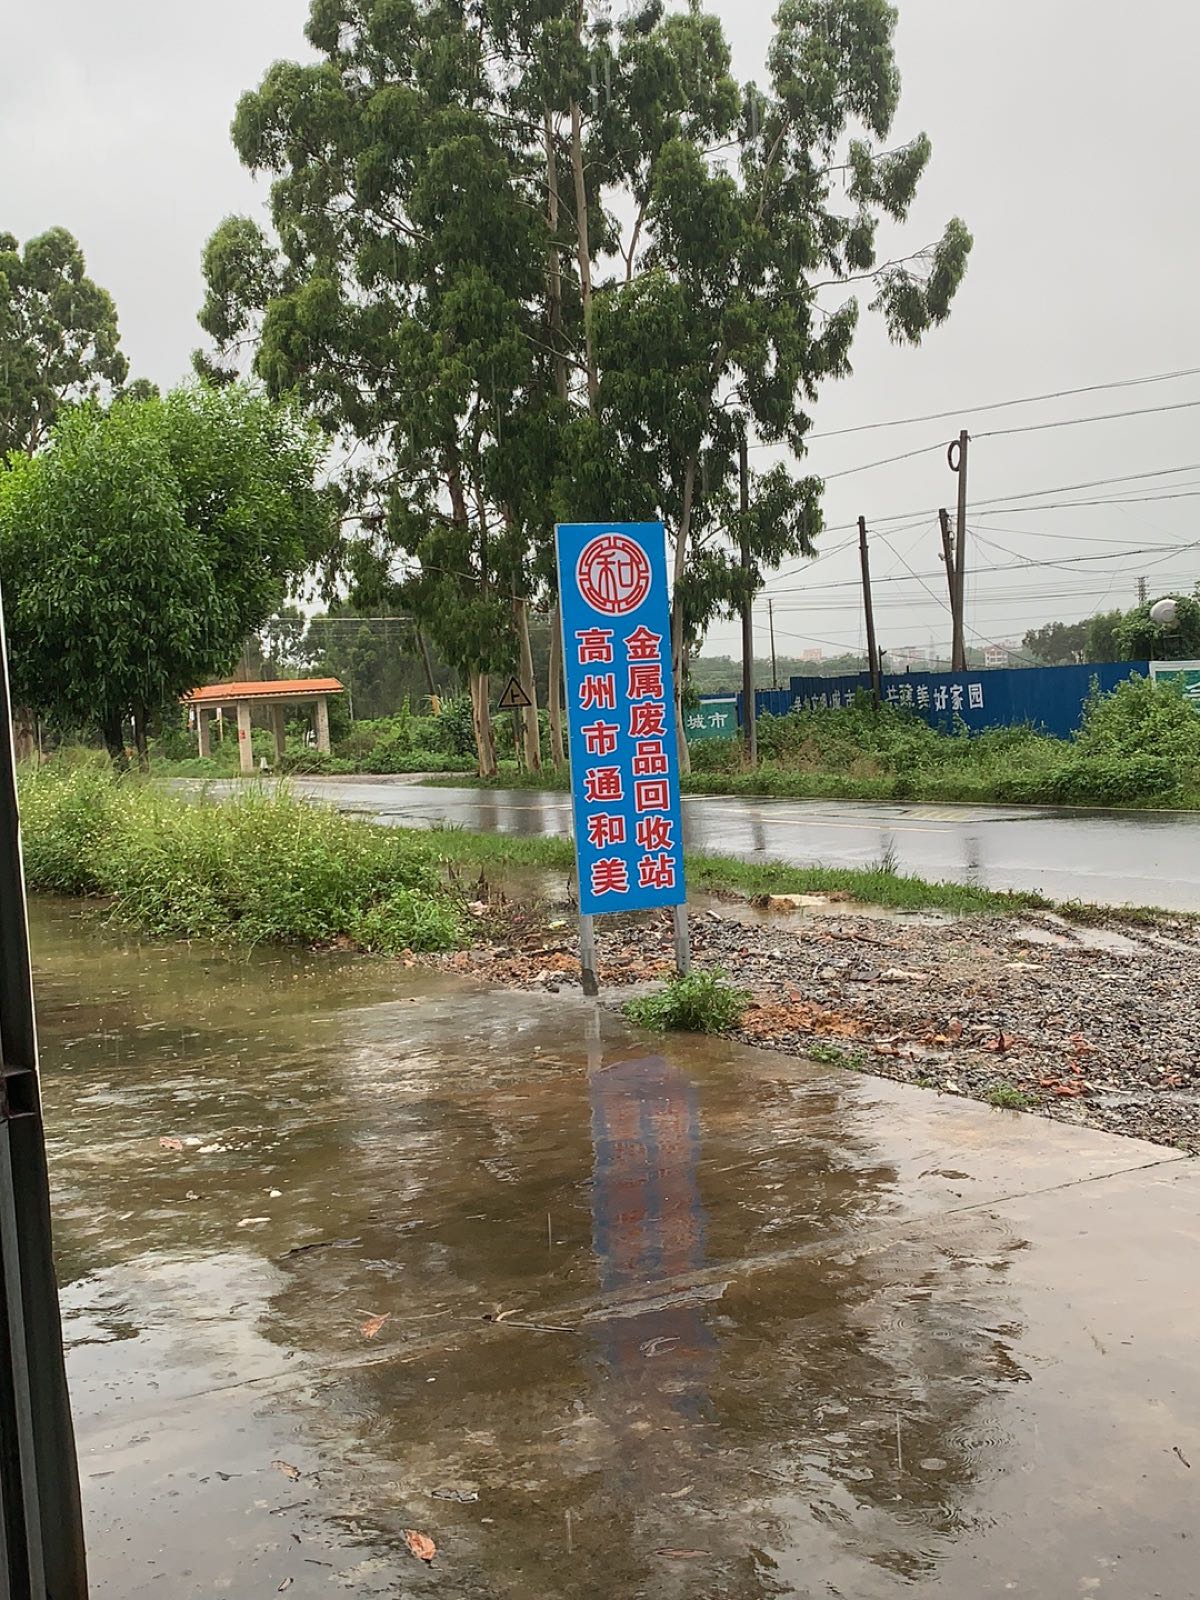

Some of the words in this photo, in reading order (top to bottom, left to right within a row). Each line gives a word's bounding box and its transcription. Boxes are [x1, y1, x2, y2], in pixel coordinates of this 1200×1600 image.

[576, 627, 629, 895] 高州市通和美
[624, 626, 676, 888] 金属废品回收站
[687, 712, 728, 729] 城市
